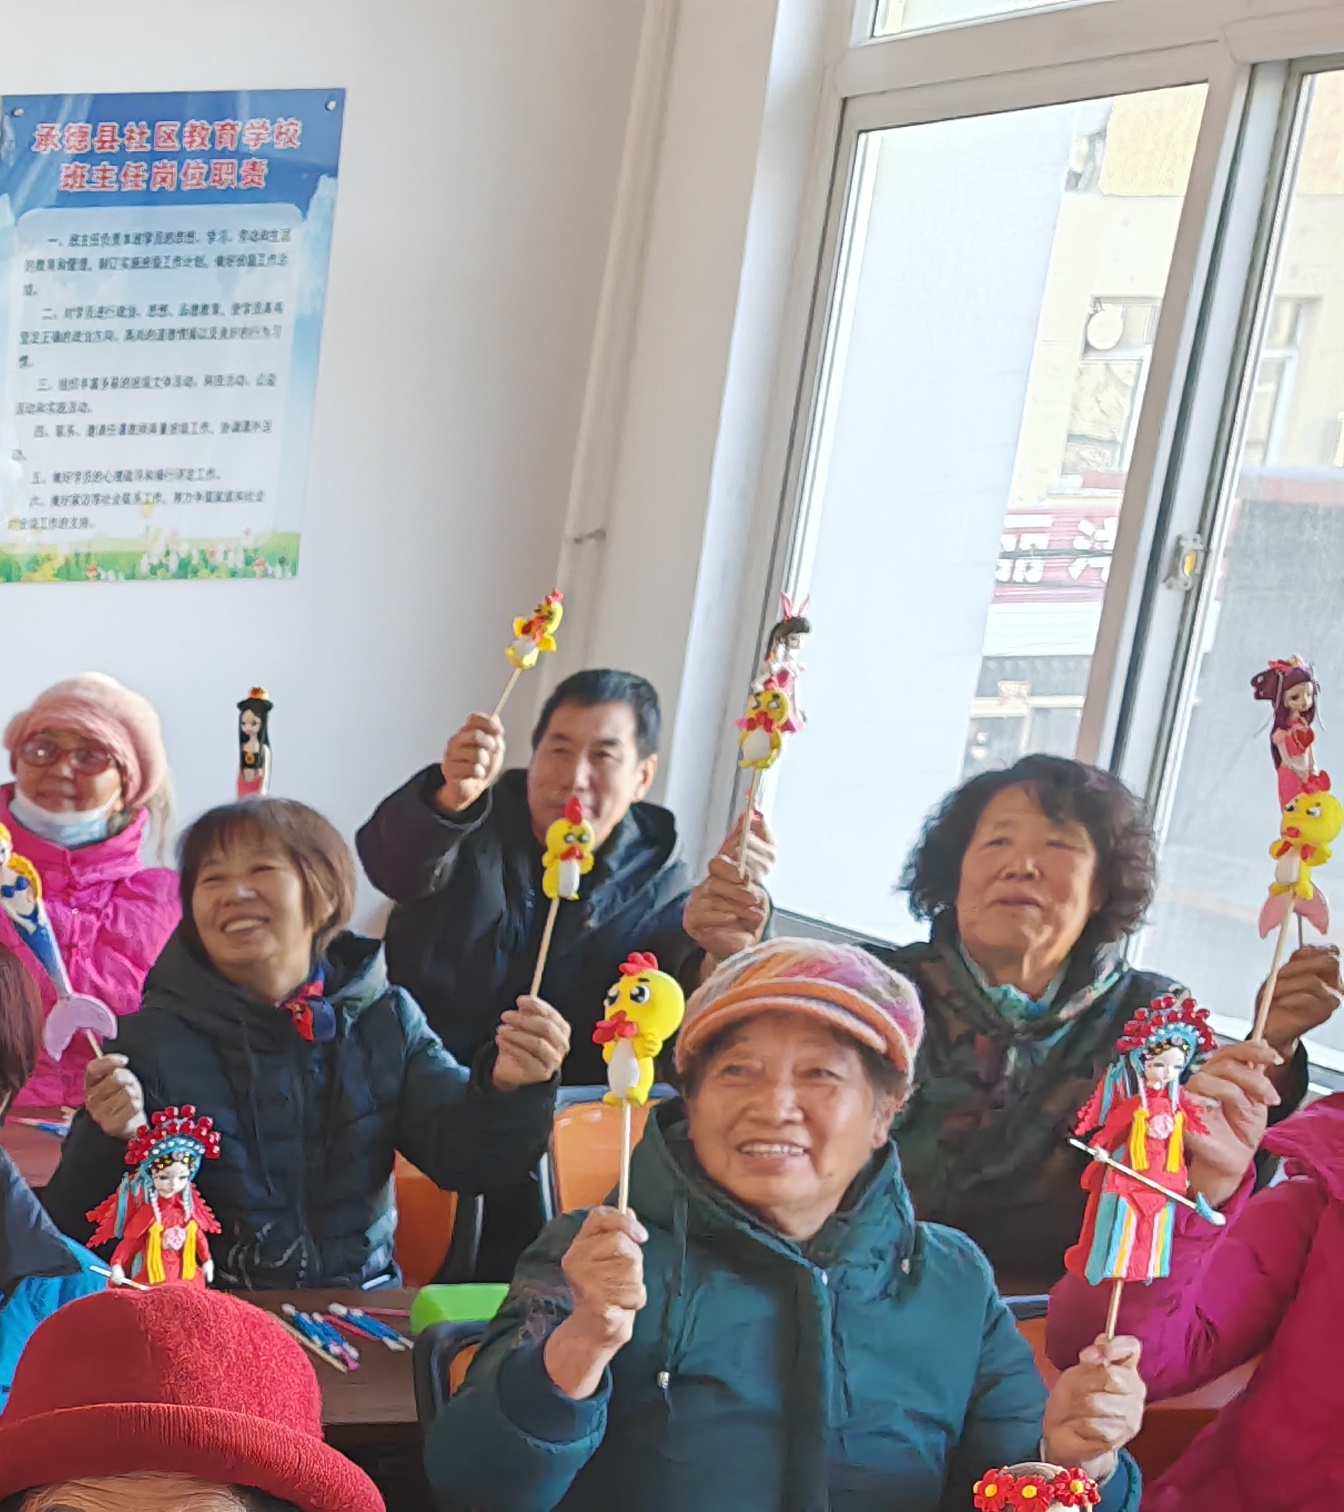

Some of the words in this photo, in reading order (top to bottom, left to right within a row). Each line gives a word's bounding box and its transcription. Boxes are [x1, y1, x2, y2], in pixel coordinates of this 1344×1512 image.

[32, 118, 303, 153] 承德县社区教育学校
[59, 159, 268, 192] 班主任岗位职责
